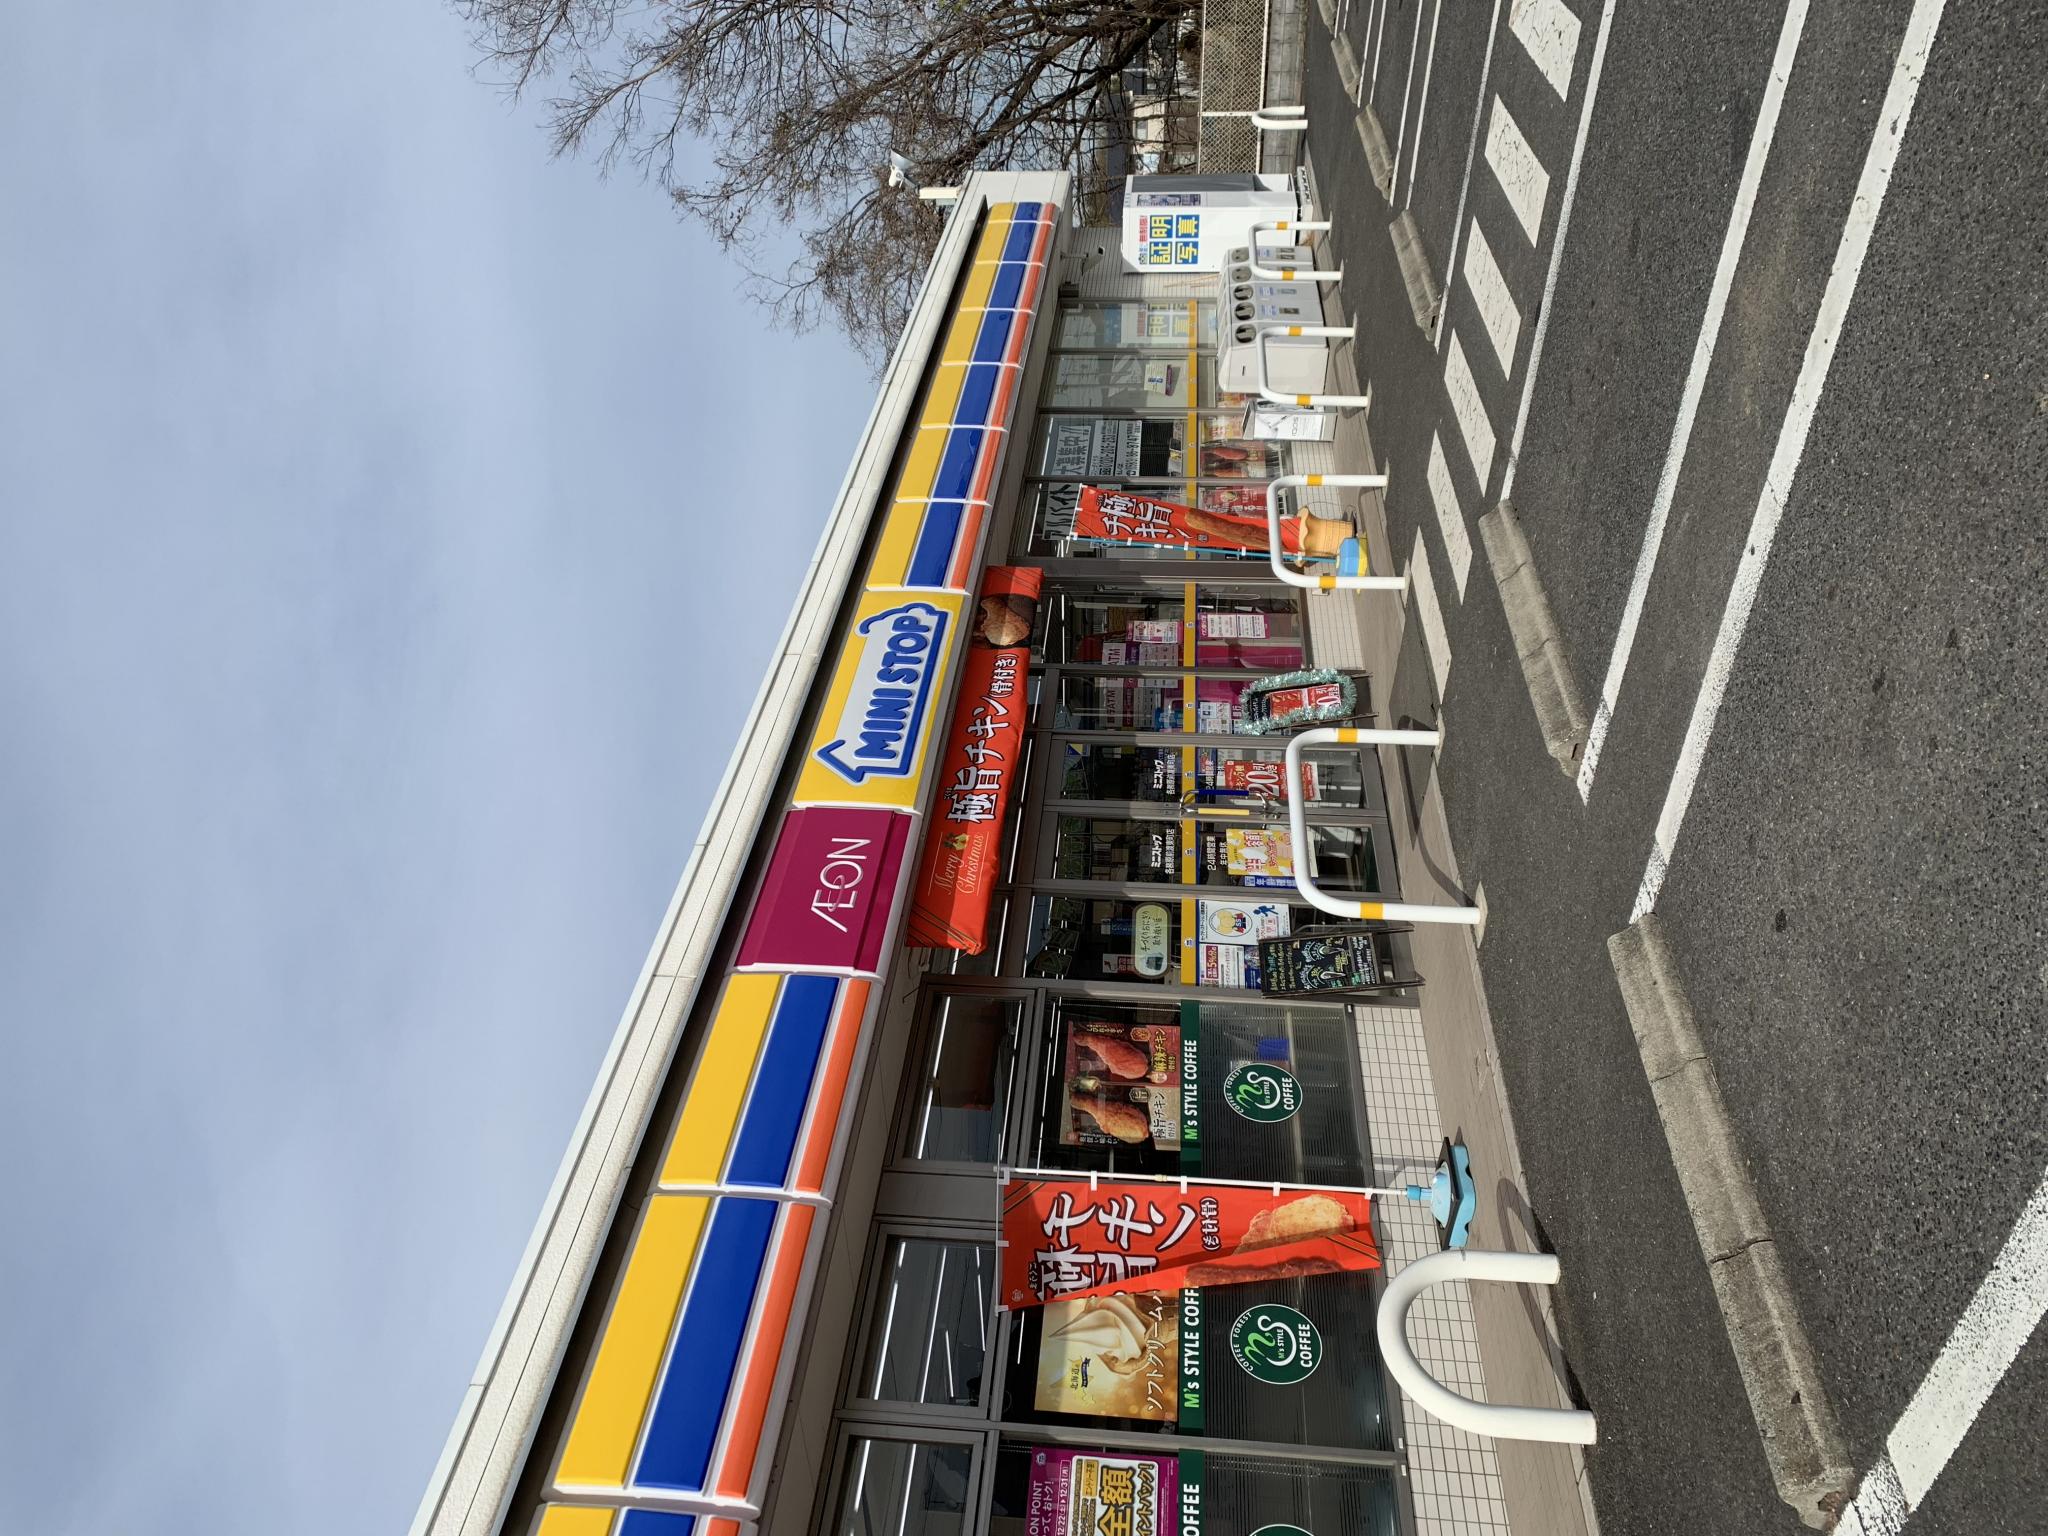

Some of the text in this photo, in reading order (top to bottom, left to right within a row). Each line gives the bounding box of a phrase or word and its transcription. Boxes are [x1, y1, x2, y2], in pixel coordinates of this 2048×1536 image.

[854, 612, 931, 759] MINI STOP
[1153, 760, 1164, 789] ミニストップ
[933, 853, 966, 896] Merry
[955, 833, 985, 894] Christmas
[1151, 834, 1162, 868] ミニストップ
[1153, 1092, 1168, 1139] 極旨チキン
[1183, 1040, 1198, 1140] M's STYLE COFFEE
[1226, 1069, 1244, 1113] COFFEE FOREST
[1282, 1077, 1295, 1110] COFFEE
[1183, 1286, 1200, 1408] M's STYLE COFF
[1233, 1311, 1254, 1372] COFFEE FOREST
[1276, 1328, 1285, 1347] STYLE
[1298, 1322, 1313, 1368] COFFEE
[1029, 1480, 1043, 1536] ON POINT
[1041, 1481, 1054, 1536] って、おトク!
[1098, 1466, 1135, 1536] 全額
